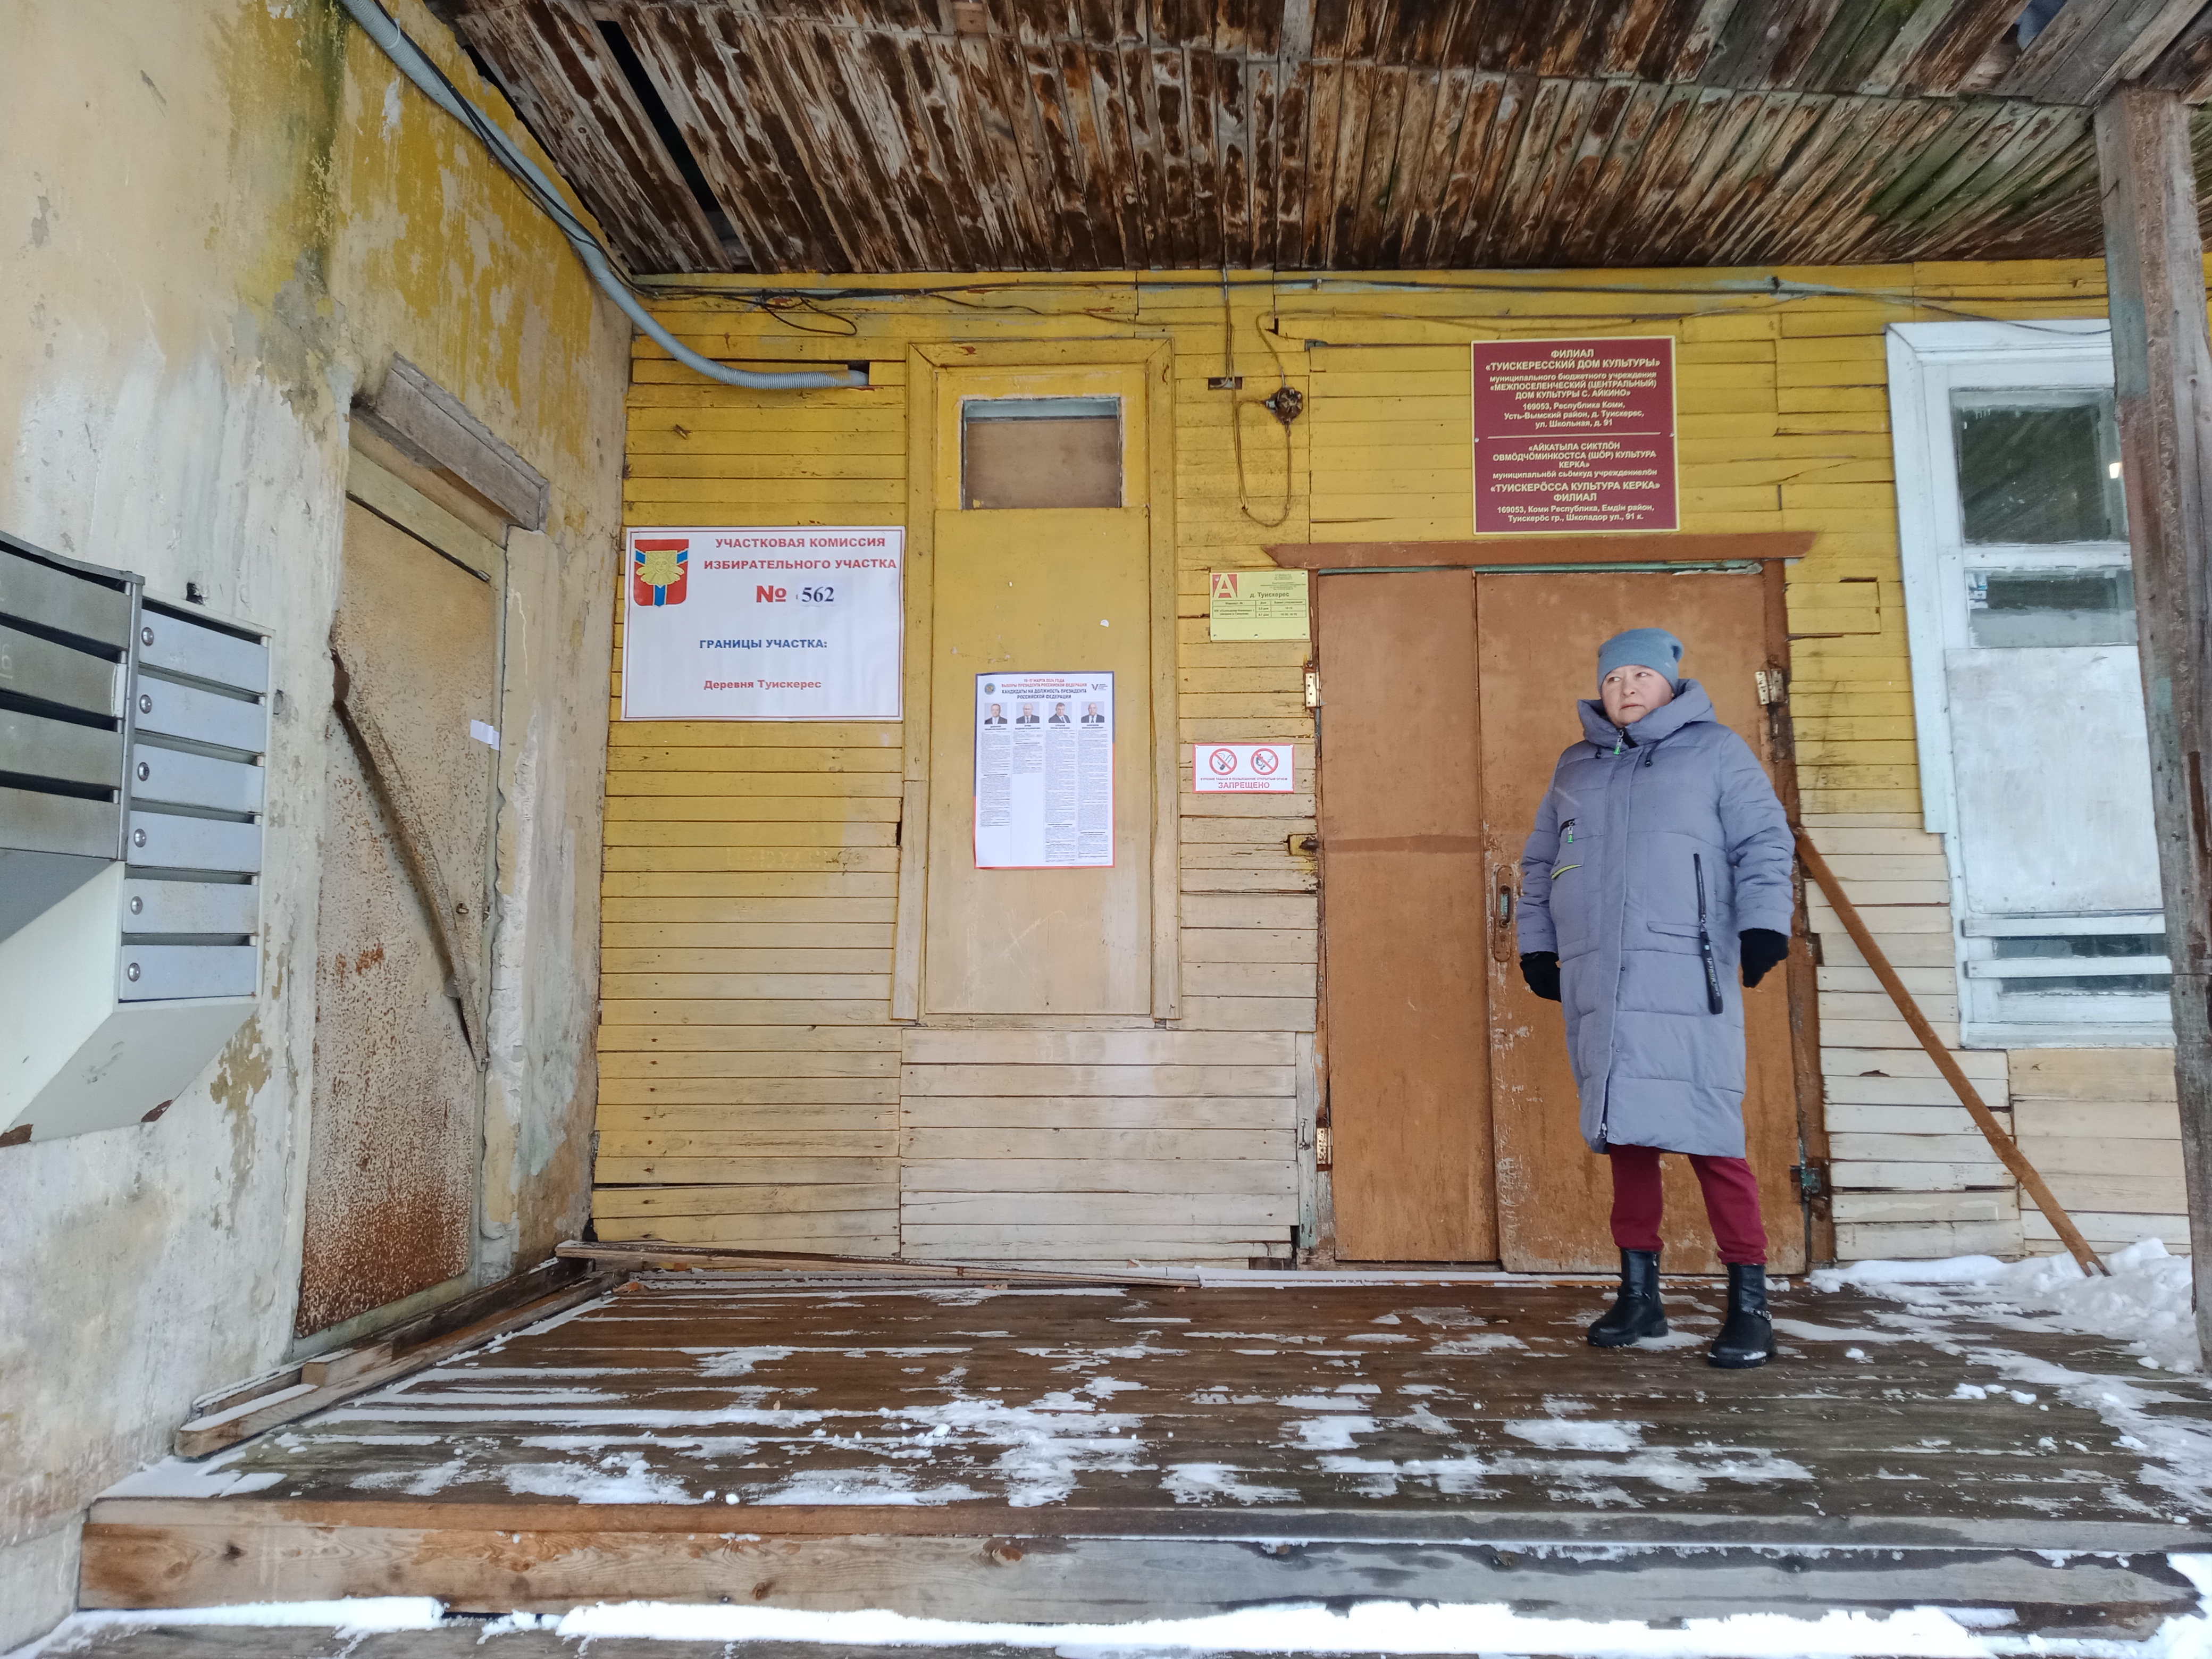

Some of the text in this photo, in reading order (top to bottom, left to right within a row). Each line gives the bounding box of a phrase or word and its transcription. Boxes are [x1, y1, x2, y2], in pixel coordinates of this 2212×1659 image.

[1551, 349, 1594, 358] ФИЛИАЛ
[1485, 358, 1661, 371] «ТУИСКЕРЕССКИЙ ДОМ КУЛЬТУРЫ»
[1490, 371, 1657, 383] муниципального бюджетного учреждения
[1490, 379, 1657, 391] «МЕЖПОСЕЛЕНЧЕСКИЙ (ЦЕНТРАЛЬНЫЙ)
[1515, 391, 1535, 400] ДОМ
[1536, 390, 1580, 399] КУЛЬТУРЫ
[1591, 388, 1631, 398] АЙКИНО»
[1554, 401, 1601, 410] Республика
[1602, 400, 1626, 409] Коми,
[1504, 411, 1562, 420] Усть-Вымский
[1563, 411, 1590, 420] район,
[1601, 409, 1645, 418] Туискерес,
[1549, 419, 1593, 428] Школьная,
[1528, 442, 1579, 451] «АЙКАТЫЛА
[1571, 481, 1621, 491] КУЛЬТУРА
[1622, 481, 1660, 490] КЕРКА»
[1553, 493, 1597, 501] ФИЛИАЛ
[1551, 505, 1600, 514] Республика,
[716, 538, 885, 548] УЧАСТКОВАЯ КОМИССИЯ
[704, 558, 896, 569] ИЗБИРАТЕЛЬНОГО УЧАСТКА
[756, 585, 834, 602] № 562
[700, 639, 827, 650] ГРАНИЦЫ УЧАСТКА:
[703, 680, 822, 690] Деревня Туискерес
